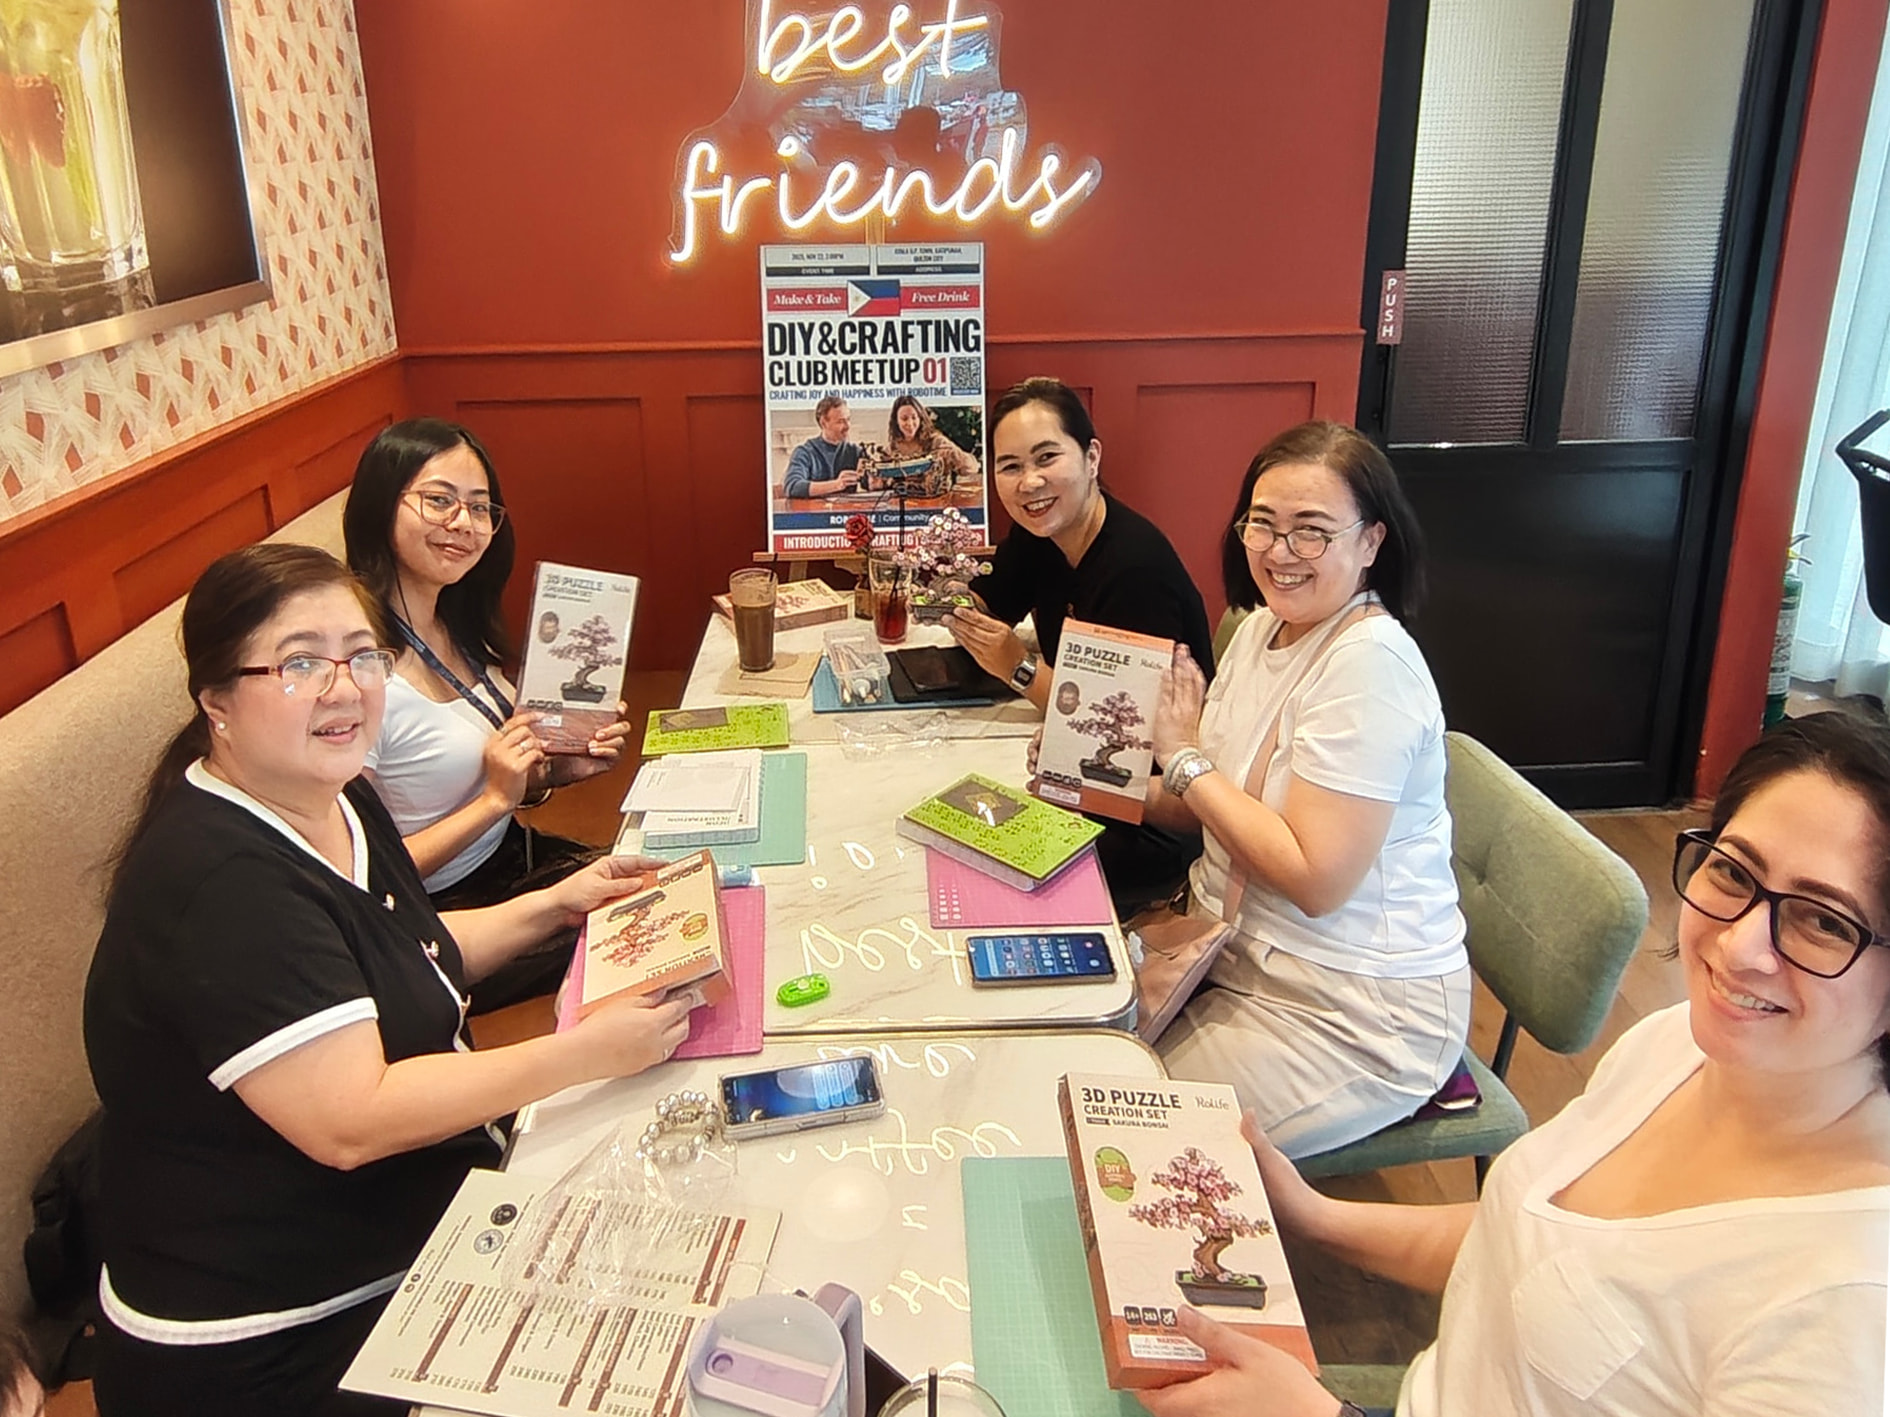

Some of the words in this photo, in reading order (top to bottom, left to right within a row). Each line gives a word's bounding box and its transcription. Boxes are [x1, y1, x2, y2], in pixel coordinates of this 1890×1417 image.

[757, 0, 989, 84] best
[669, 126, 1096, 263] friends
[774, 293, 804, 306] Make
[804, 293, 813, 305] &
[814, 292, 842, 305] Take
[911, 292, 936, 304] Free
[938, 290, 970, 303] Drink
[1381, 277, 1398, 338] PUSH
[769, 360, 829, 387] CLUB
[831, 358, 921, 386] MEETUP
[923, 357, 947, 384] 01
[769, 389, 808, 400] CRAFTING
[808, 389, 823, 399] JOY
[824, 388, 840, 399] AND
[841, 387, 885, 398] HAPPINESS
[886, 387, 906, 397] WITH
[907, 386, 947, 397] ROBOTIME
[1063, 653, 1102, 667] CREATION
[1103, 662, 1118, 672] SET
[1065, 642, 1082, 655] 3D
[1084, 646, 1131, 666] PUZZLE
[1081, 1087, 1106, 1103] 3D
[1110, 1089, 1182, 1109] PUZZLE
[1083, 1104, 1144, 1119] CREATION
[1145, 1108, 1168, 1120] SET
[1104, 1163, 1121, 1174] DIY
